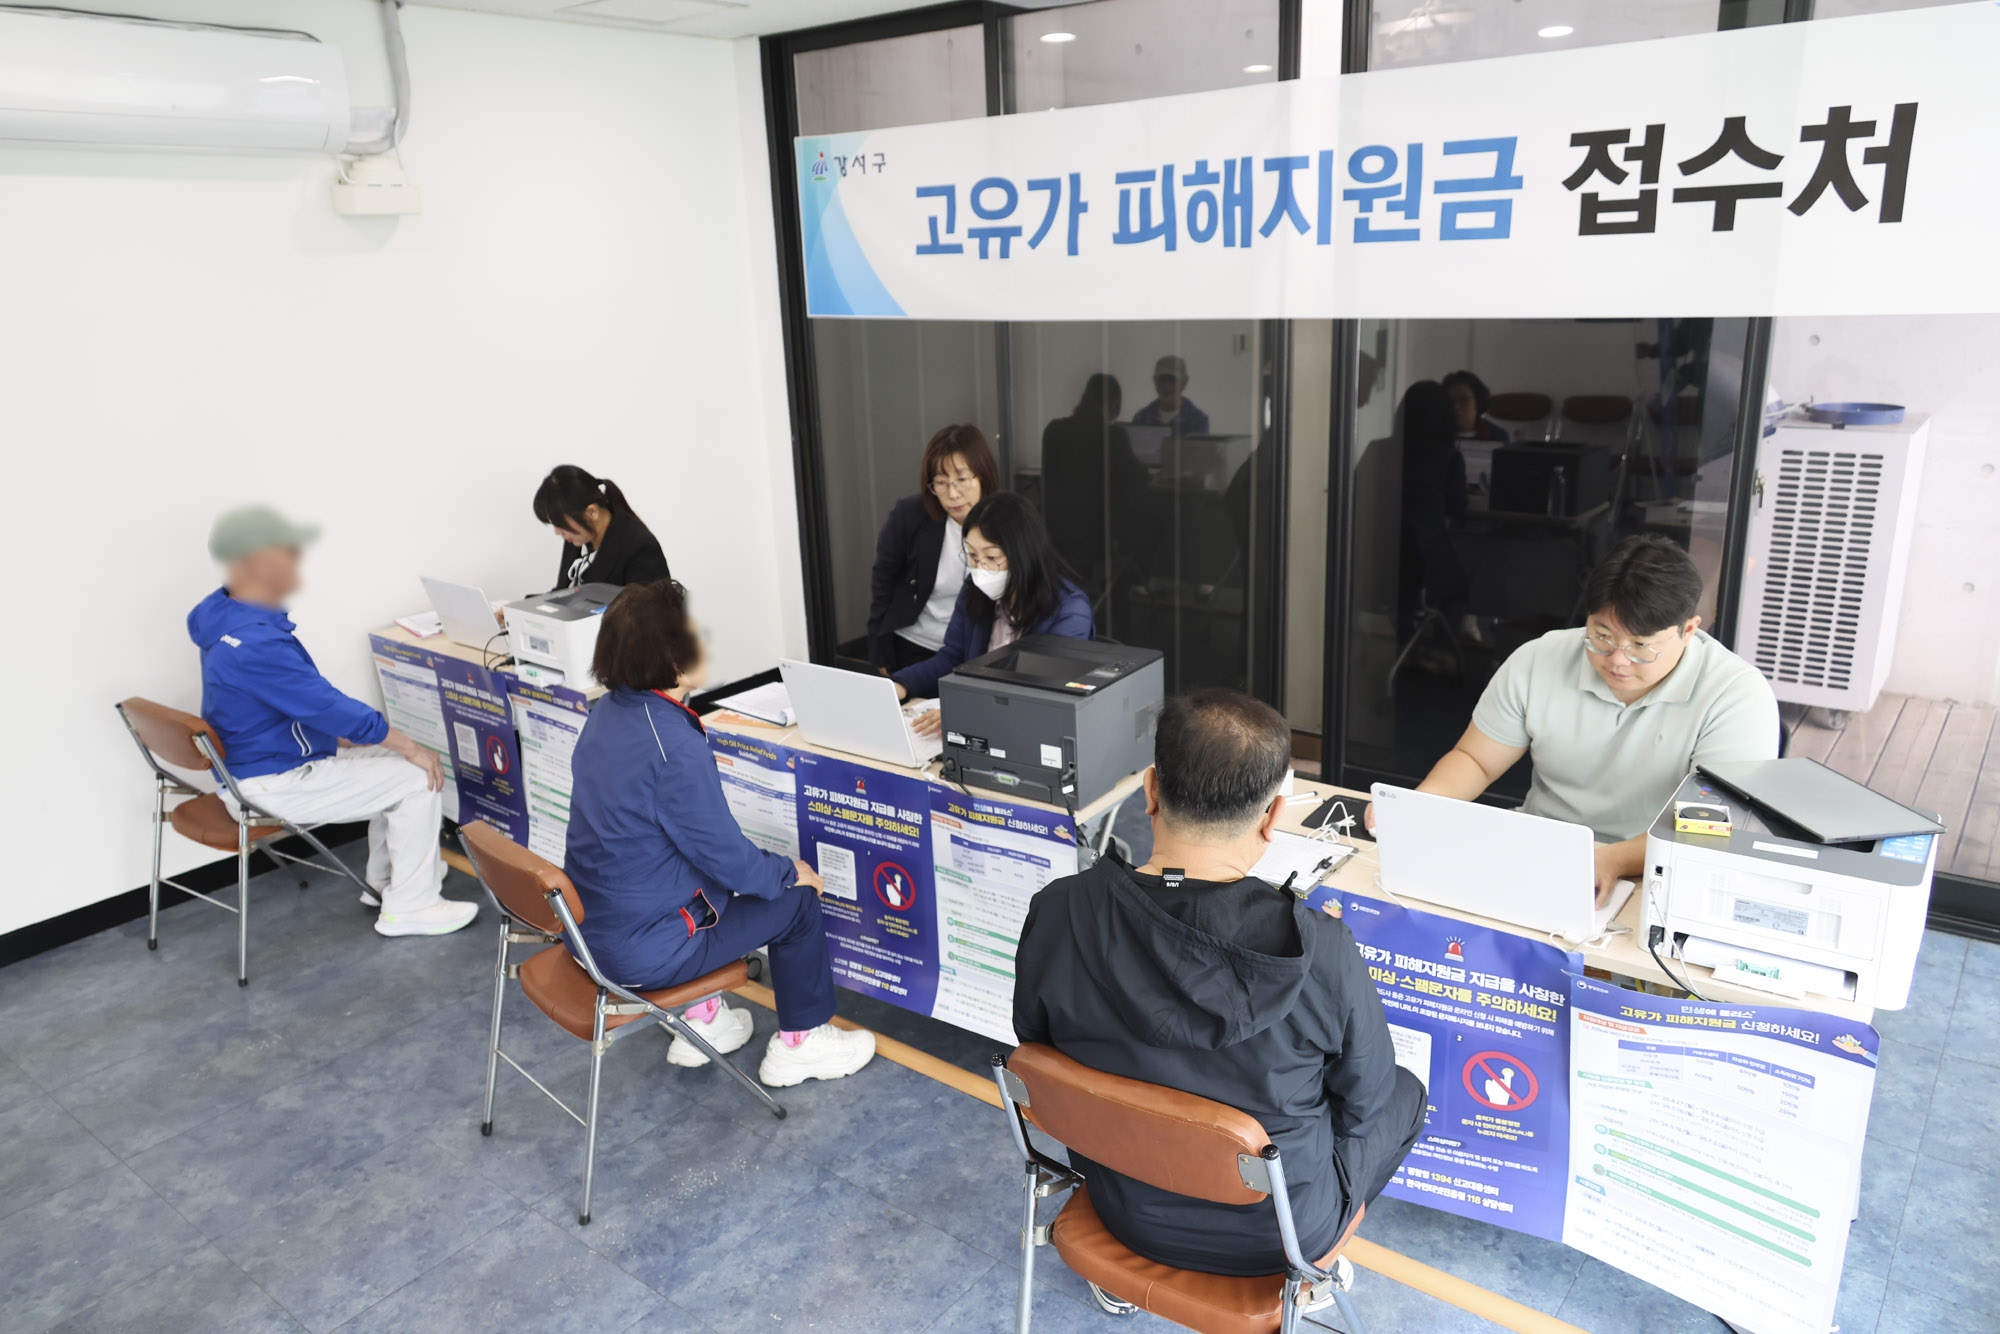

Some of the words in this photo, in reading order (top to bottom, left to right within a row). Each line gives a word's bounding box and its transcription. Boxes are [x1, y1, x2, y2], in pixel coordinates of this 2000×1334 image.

[833, 152, 887, 177] 강서구
[914, 171, 1088, 260] 고유가
[1112, 136, 1524, 252] 피해지원금
[1561, 102, 1918, 236] 접수처
[804, 784, 828, 800] 고유가
[829, 791, 869, 811] 피해지원금
[870, 801, 896, 818] 지급을
[897, 808, 923, 825] 사칭한
[947, 802, 967, 818] 고유가
[968, 810, 1006, 826] 피해지원금
[1007, 818, 1049, 836] 신청하세요!
[875, 816, 920, 838] 주의하세요!
[1394, 954, 1466, 983] 피해지원금
[1469, 971, 1516, 993] 지급을
[1519, 983, 1565, 1007] 사칭한
[1405, 995, 1422, 1006] 고유가
[1423, 1000, 1453, 1012] 피해지원금
[1454, 1006, 1473, 1017] 온라인
[1474, 1011, 1486, 1020] 신청
[1487, 1014, 1494, 1022] 시
[1476, 992, 1557, 1023] 주의하세요!
[1681, 1006, 1717, 1016] 민생에
[1620, 1006, 1662, 1022] 고유가
[1665, 1014, 1737, 1029] 피해지원금
[1741, 1020, 1820, 1045] 신청하세요!
[1431, 1172, 1453, 1185] 1394
[1453, 1178, 1500, 1196] 신고대응센터
[1467, 1193, 1481, 1205] 118
[1482, 1197, 1514, 1213] 상담센터
